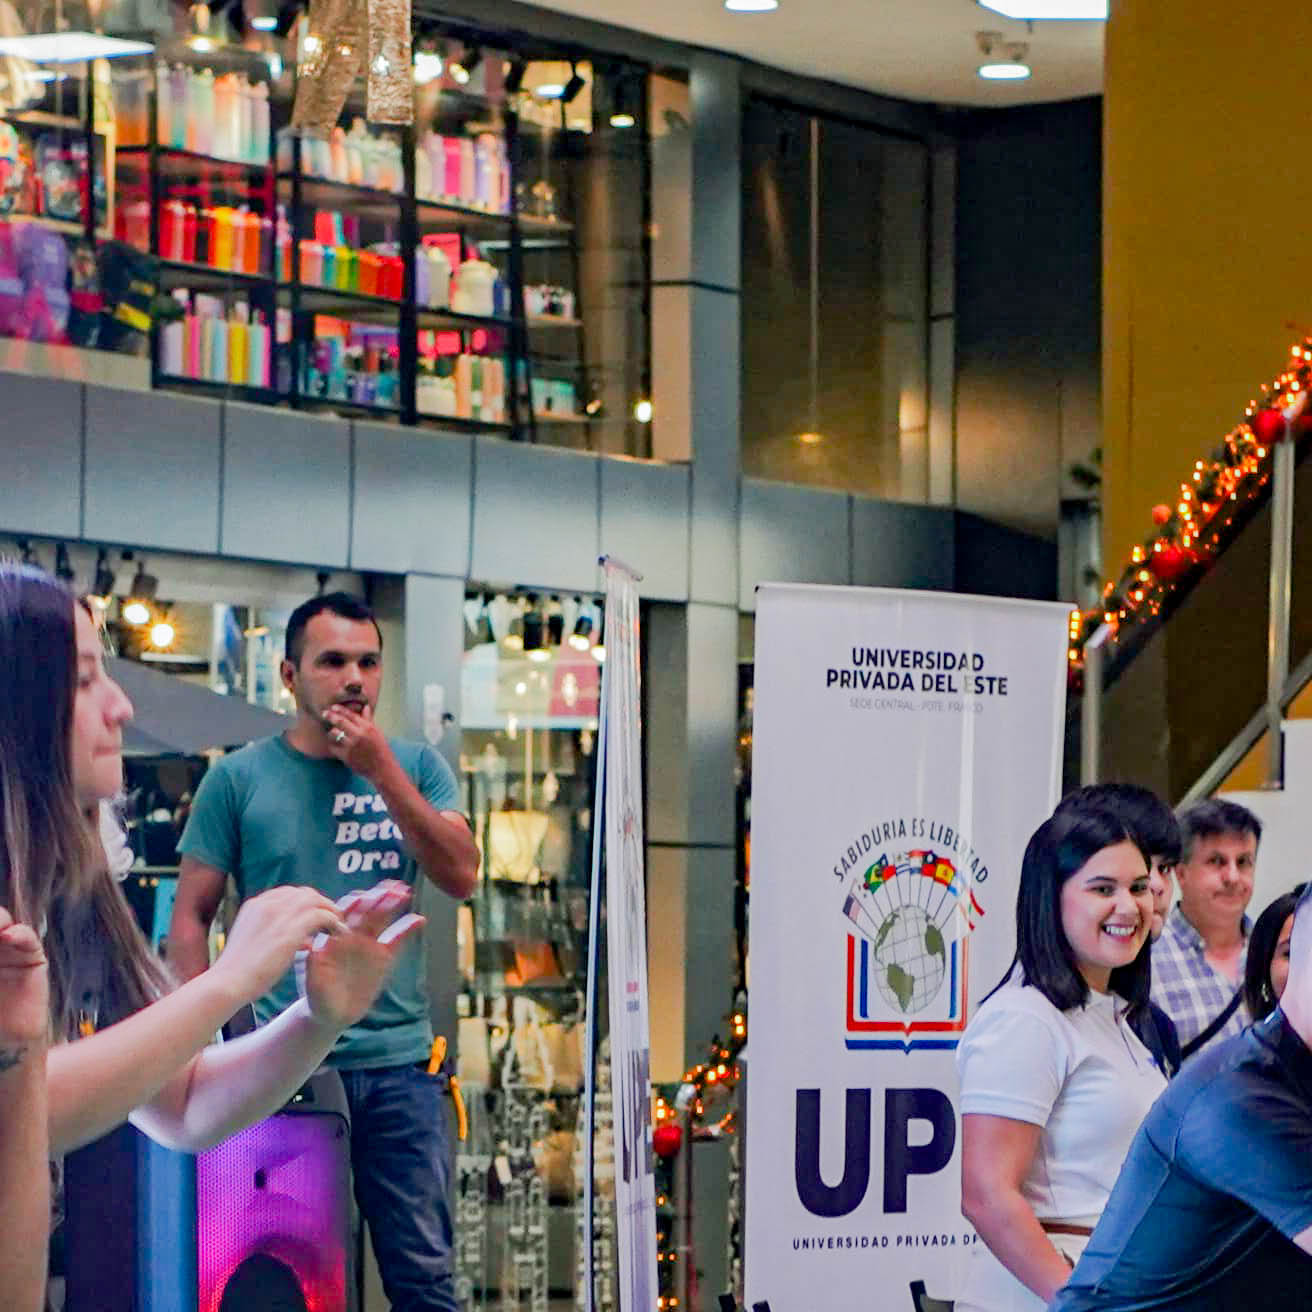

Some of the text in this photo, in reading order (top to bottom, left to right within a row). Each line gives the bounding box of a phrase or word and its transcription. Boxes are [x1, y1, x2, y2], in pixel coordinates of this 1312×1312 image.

[852, 647, 984, 672] UNIVERSIDAD
[826, 669, 914, 692] PRIVADA
[921, 674, 958, 693] DEL
[833, 818, 907, 883] SABIDURIA
[912, 818, 925, 837] ES
[795, 1087, 956, 1219] UP
[793, 1236, 888, 1250] UNIVERSIDAD
[896, 1234, 956, 1248] PRIVADA
